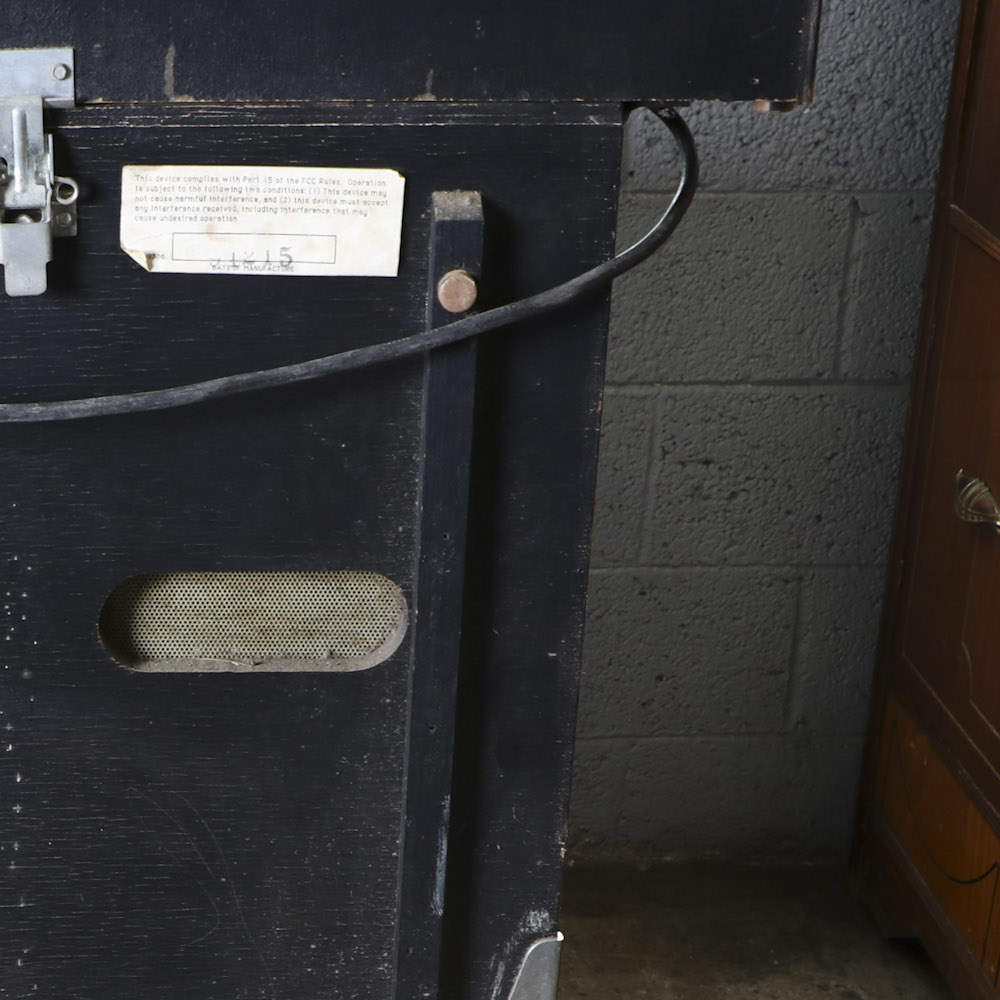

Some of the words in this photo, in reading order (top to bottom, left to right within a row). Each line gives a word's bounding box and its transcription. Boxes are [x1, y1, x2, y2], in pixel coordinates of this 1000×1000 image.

[204, 186, 242, 194] following
[371, 190, 387, 198] may
[135, 205, 148, 213] any
[242, 206, 278, 214] including
[281, 206, 330, 214] interference
[333, 207, 349, 215] that
[352, 209, 368, 217] may
